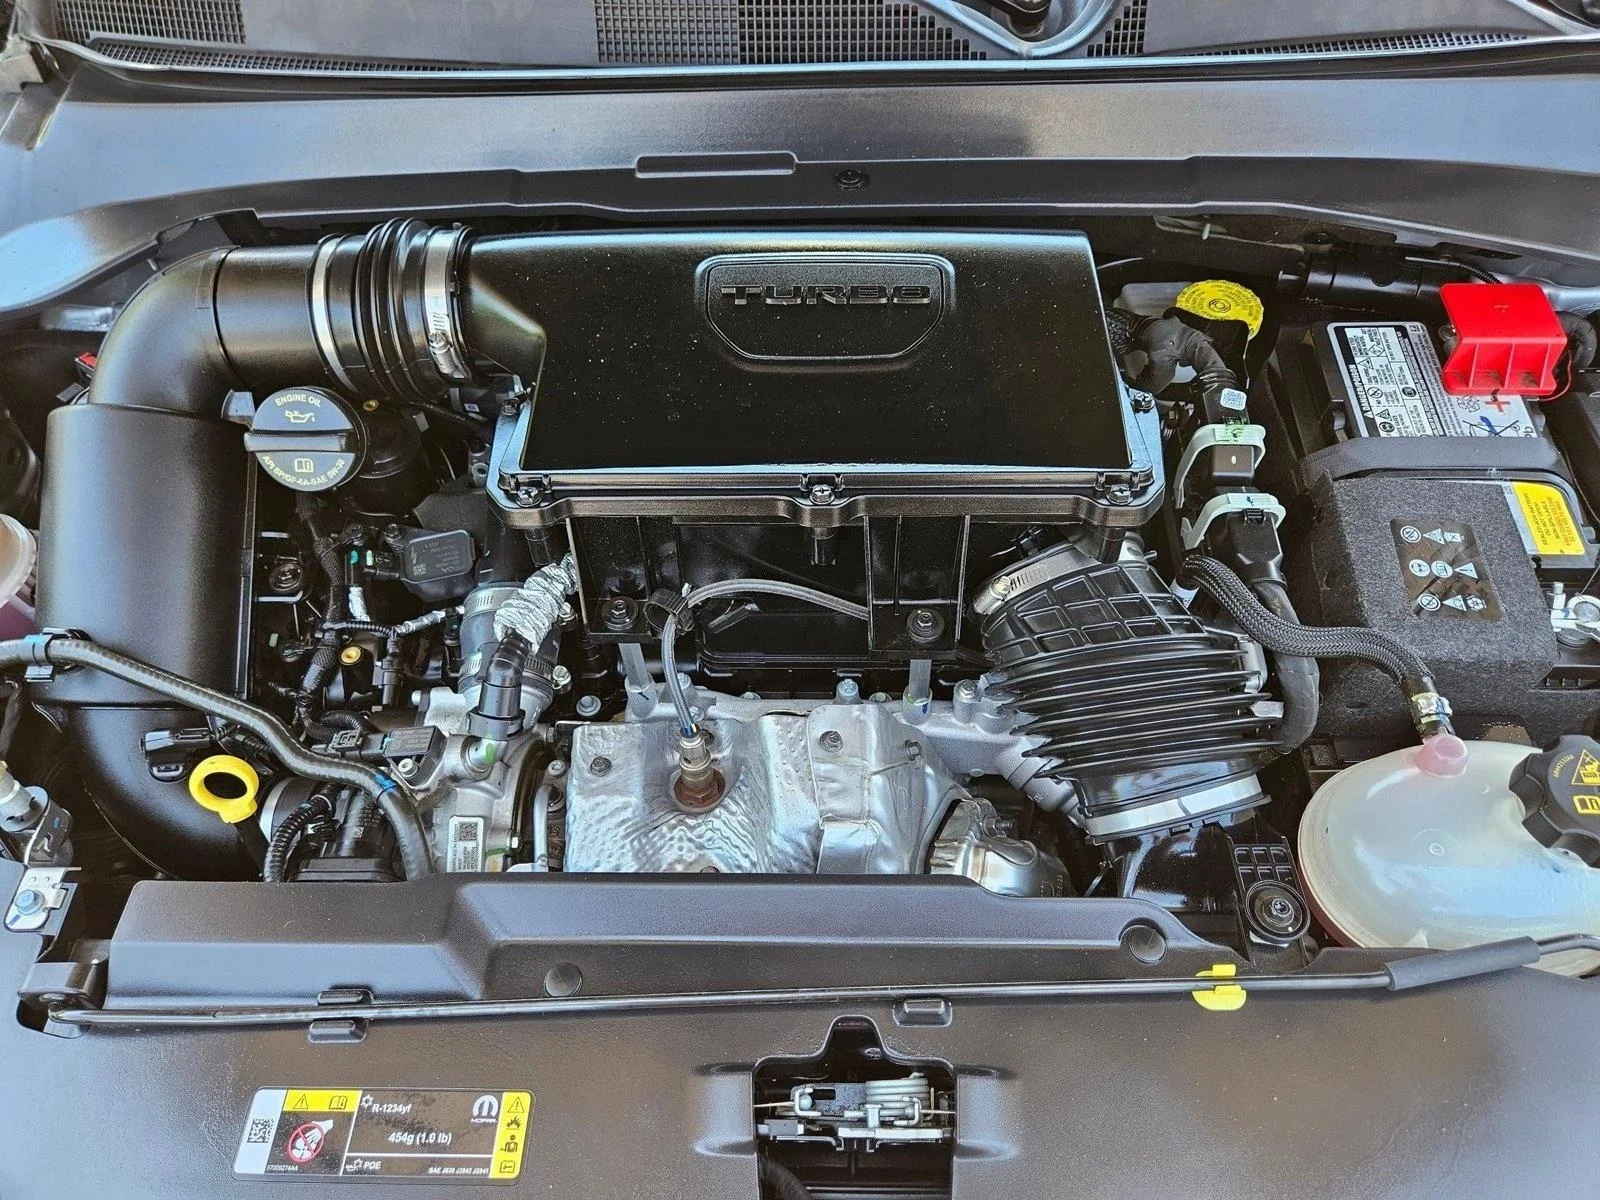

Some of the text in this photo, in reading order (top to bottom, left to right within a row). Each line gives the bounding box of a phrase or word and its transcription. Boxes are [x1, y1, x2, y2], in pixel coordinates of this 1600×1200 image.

[721, 285, 931, 305] TURBO
[276, 394, 322, 408] ENGINE OIL
[263, 456, 275, 470] API
[328, 459, 345, 478] 5W-30
[372, 1103, 412, 1114] R-1234yf
[387, 1132, 452, 1146] 454g (1.0 lb)
[364, 1162, 381, 1170] POE
